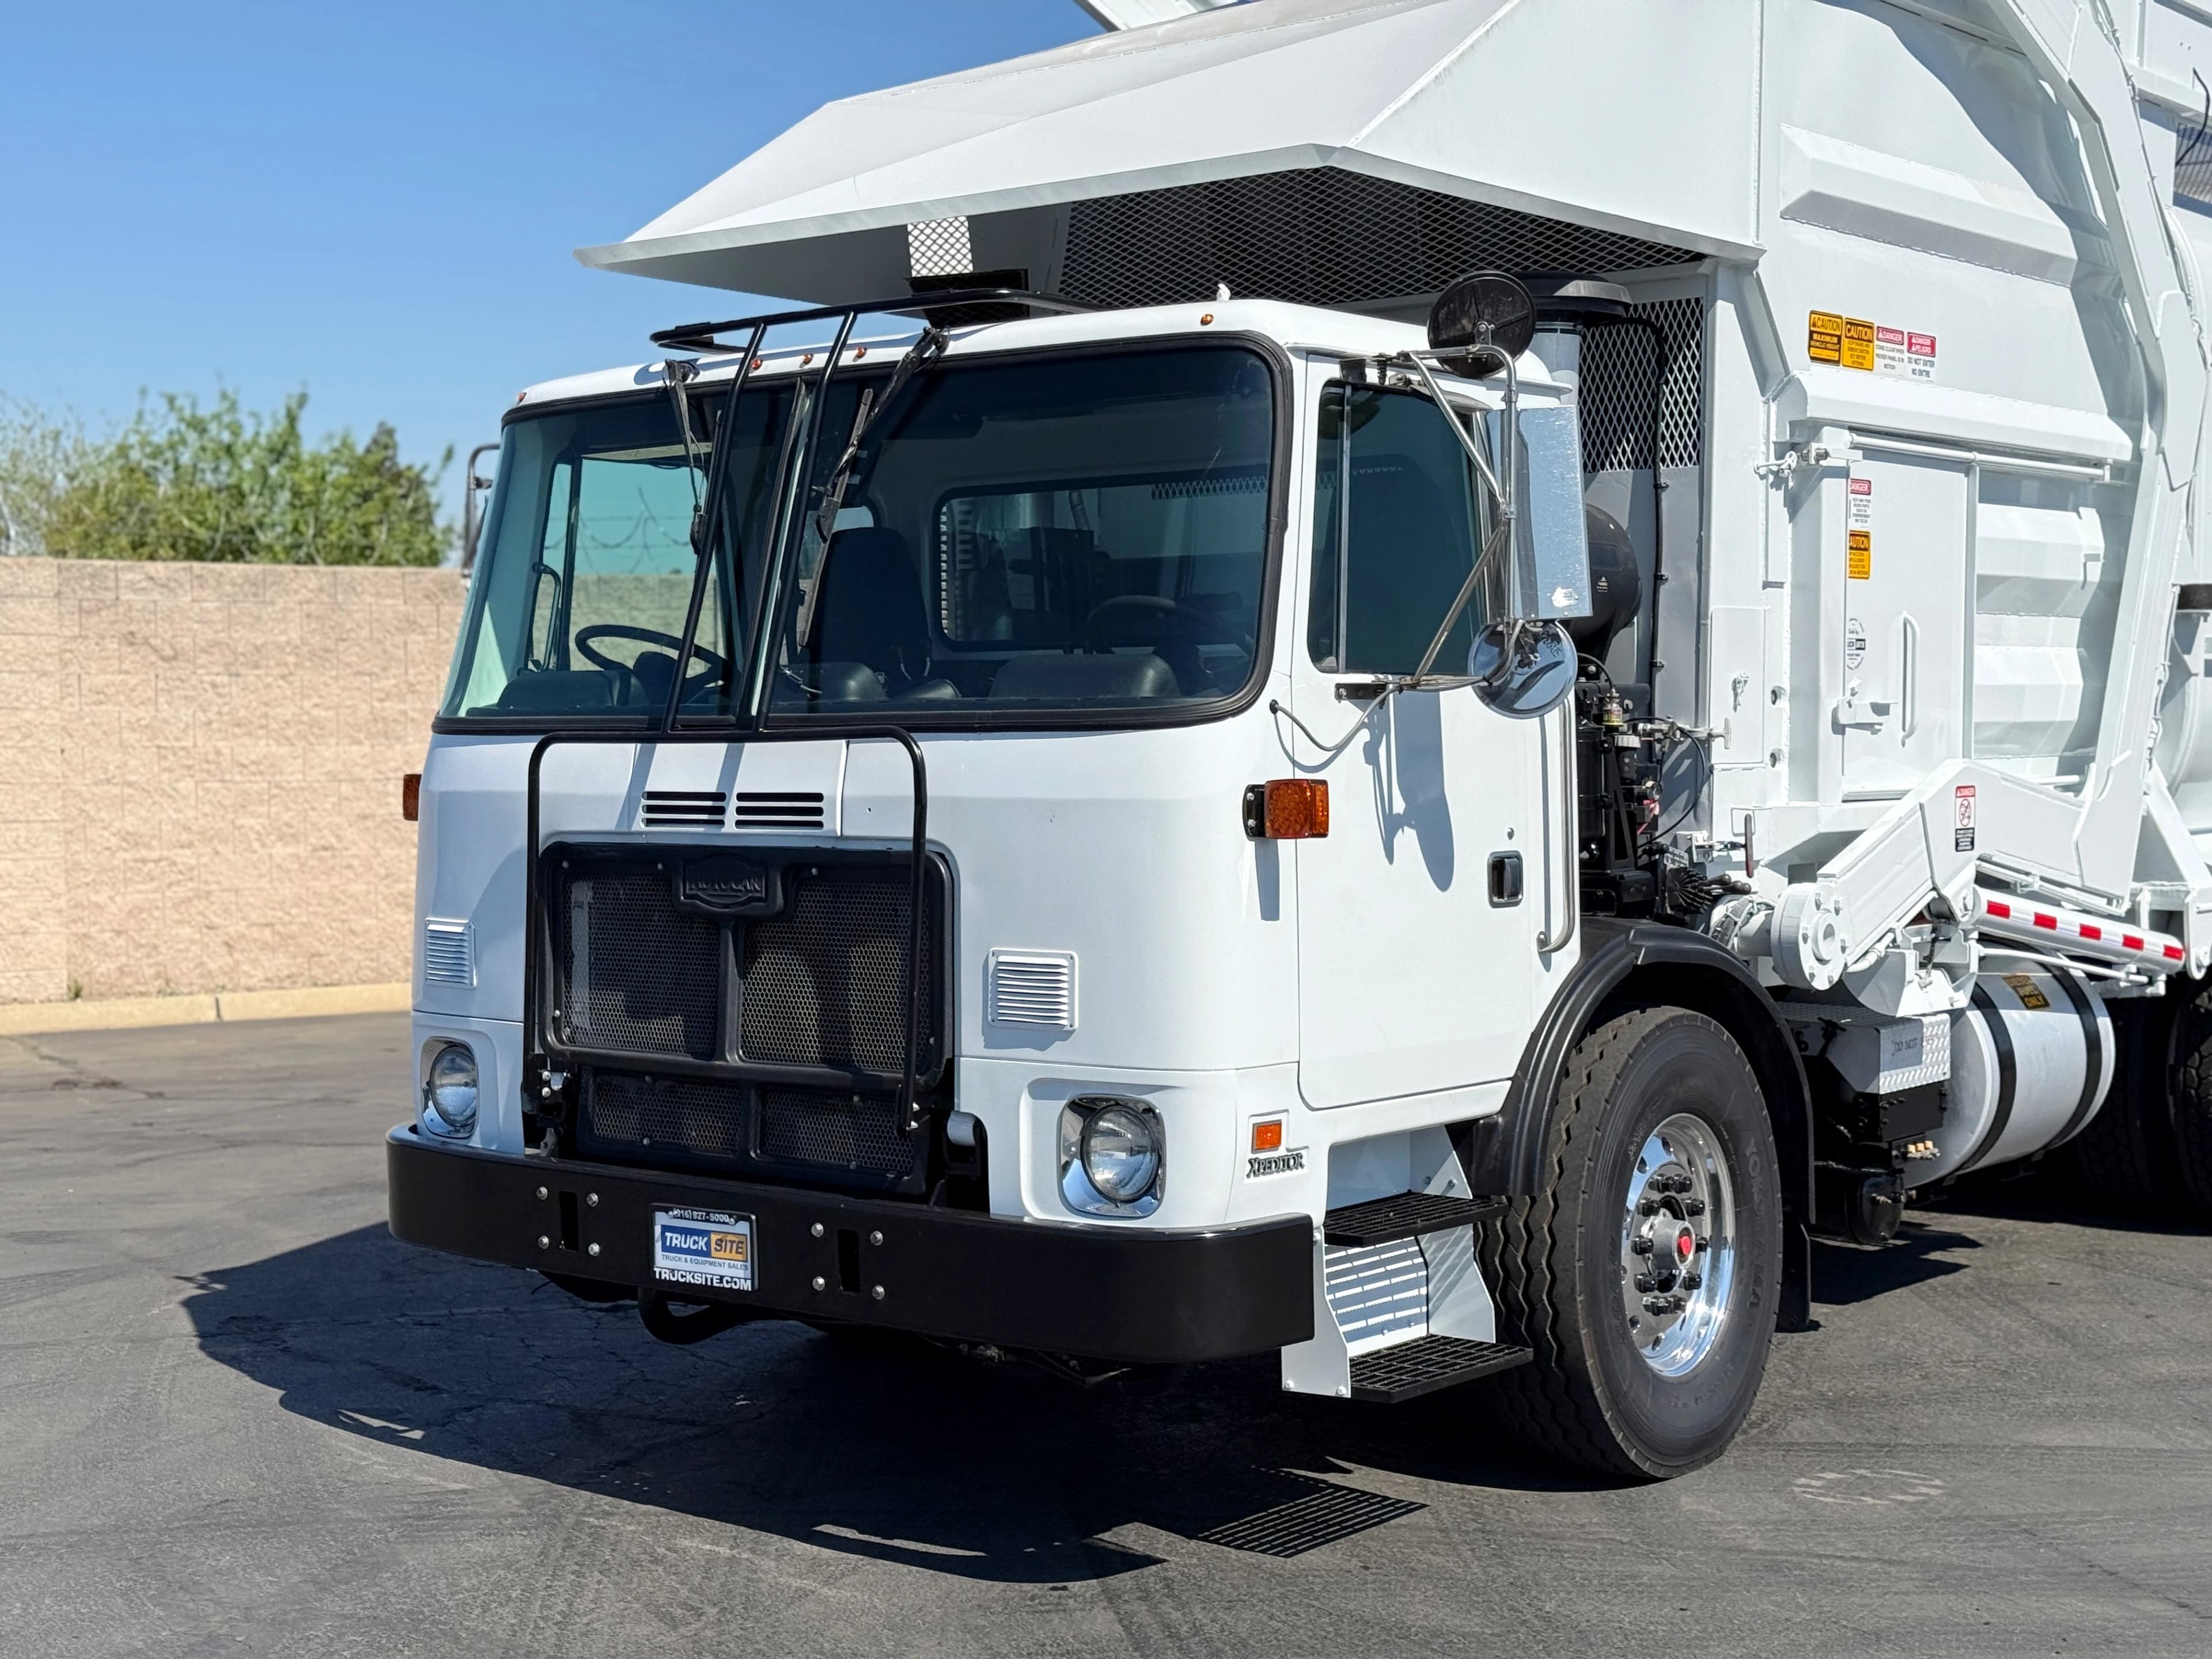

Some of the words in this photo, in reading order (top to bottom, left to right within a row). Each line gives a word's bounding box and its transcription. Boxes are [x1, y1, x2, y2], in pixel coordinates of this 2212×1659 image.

[1817, 317, 1840, 332] CAUTION
[1846, 324, 1872, 341] CAUTION
[1849, 535, 1869, 548] AUTION
[2024, 995, 2045, 1006] ONLY
[1246, 1152, 1305, 1179] XPEDITOR
[692, 1211, 729, 1223] 927-5000
[665, 1232, 708, 1251] TRUCK
[714, 1238, 744, 1255] SITE
[662, 1254, 683, 1263] TRUCK
[690, 1257, 726, 1268] EQUIPMENT
[728, 1263, 748, 1271] SALES
[654, 1267, 752, 1291] TRUCKSITE.COM
